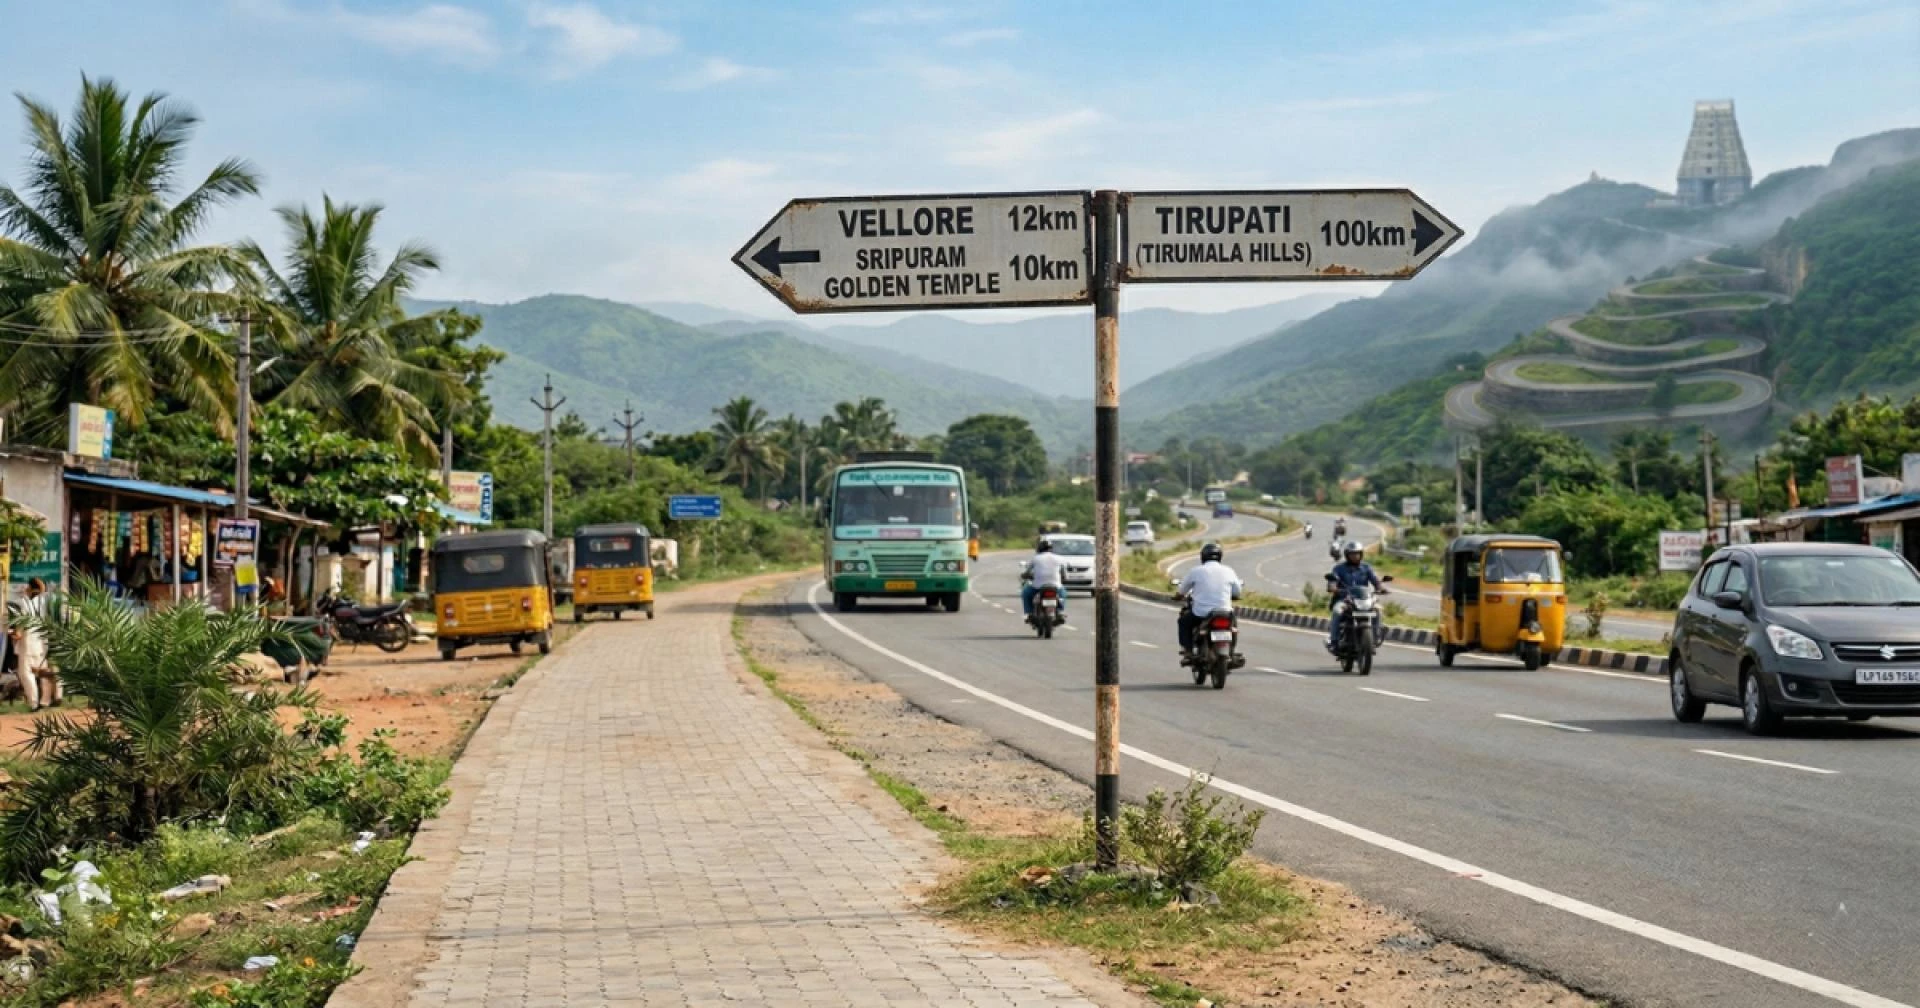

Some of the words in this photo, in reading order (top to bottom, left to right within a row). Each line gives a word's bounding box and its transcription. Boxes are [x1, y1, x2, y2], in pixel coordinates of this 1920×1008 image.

[838, 207, 974, 239] VELLORE
[1007, 204, 1078, 233] 12km
[1155, 205, 1291, 235] TIRUPATI
[1320, 220, 1405, 248] 100km
[855, 247, 966, 272] SRIPURAM
[1009, 254, 1079, 281] 10km
[1135, 243, 1244, 269] (TIRUMALA
[1249, 241, 1312, 268] HILLS)
[824, 274, 910, 300] GOLDEN
[916, 271, 1001, 297] TEMPLE
